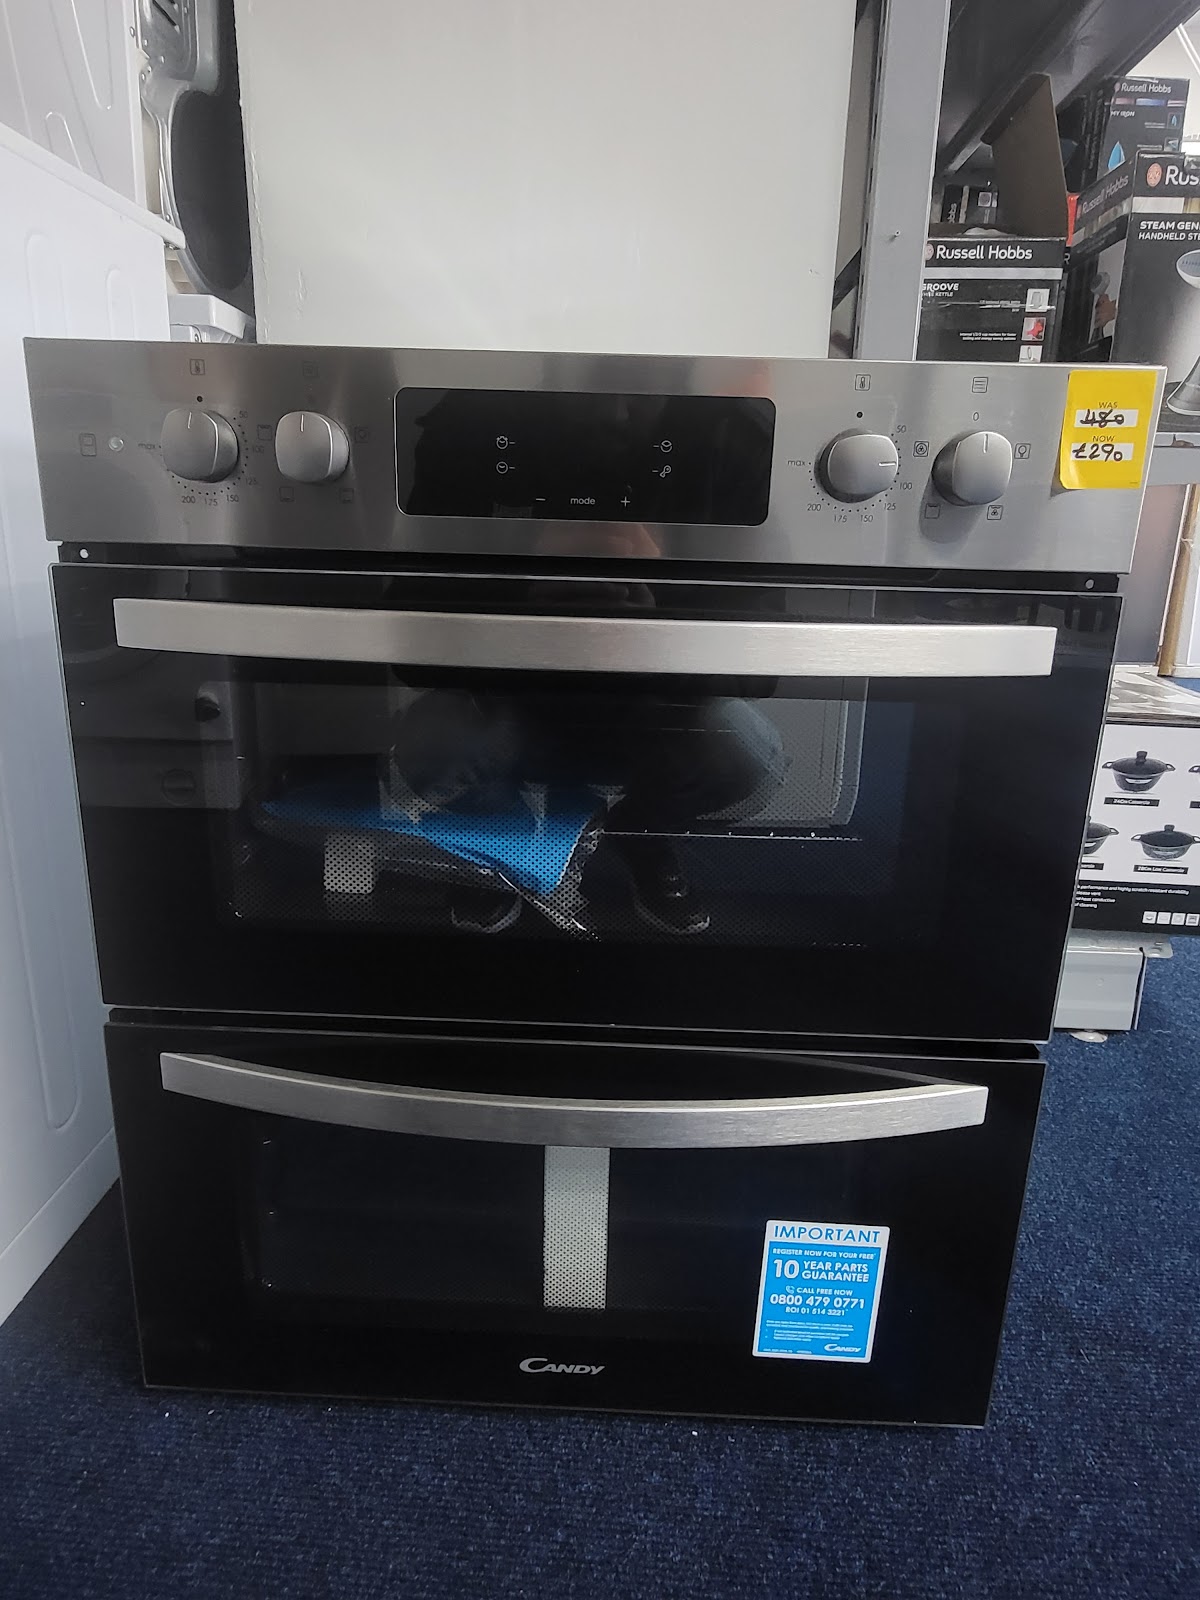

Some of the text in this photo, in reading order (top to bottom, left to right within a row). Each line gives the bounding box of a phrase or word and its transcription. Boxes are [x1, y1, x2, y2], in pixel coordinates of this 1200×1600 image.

[1121, 83, 1171, 94] Russell Hobbs
[1082, 175, 1129, 213] Russell Hobbs
[1140, 221, 1175, 230] STEAM
[1138, 232, 1186, 240] HANDHELD
[936, 245, 1033, 259] Russell Hobbs
[897, 425, 906, 433] 50
[1072, 443, 1123, 462] £290
[900, 482, 912, 490] 100
[181, 496, 196, 504] 200
[227, 495, 239, 503] 150
[570, 497, 595, 505] mode
[807, 504, 821, 512] 200
[884, 503, 896, 511] 125
[834, 515, 847, 523] 175
[861, 515, 873, 523] 150
[774, 1225, 880, 1243] IMPORTANT
[774, 1259, 868, 1279] 10 YEAR PARTS
[802, 1270, 869, 1282] GUARANTEE
[770, 1294, 865, 1309] 0800 479 0771
